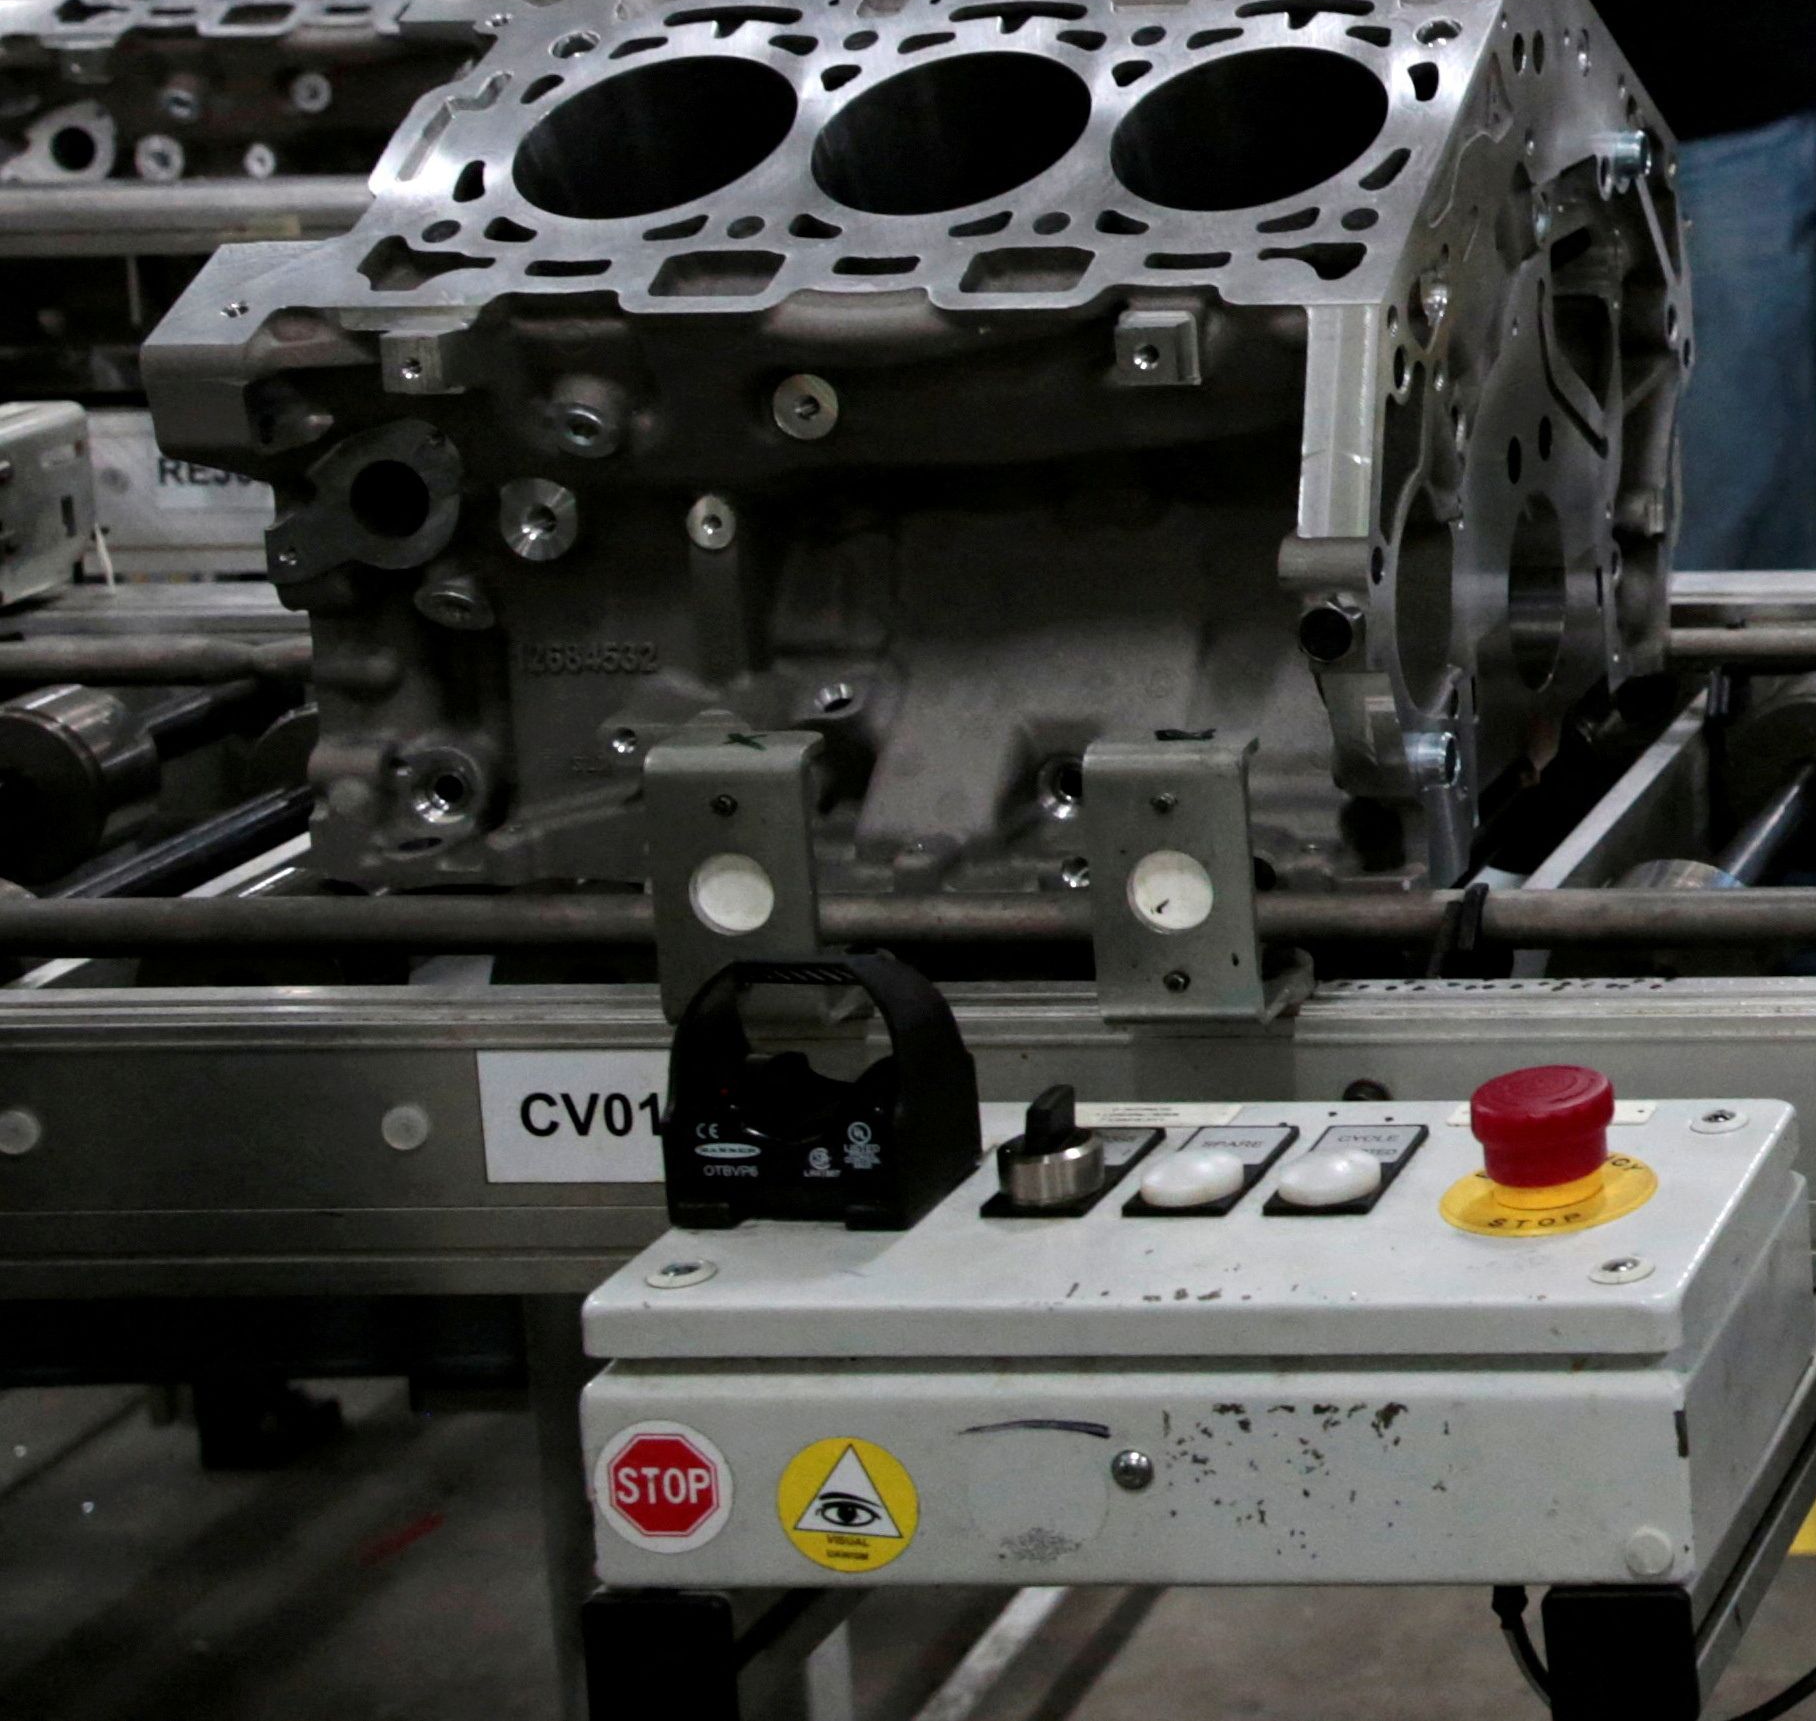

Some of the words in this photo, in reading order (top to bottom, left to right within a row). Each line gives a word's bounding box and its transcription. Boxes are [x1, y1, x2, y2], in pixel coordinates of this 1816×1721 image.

[520, 1092, 664, 1137] CV01
[1201, 1139, 1265, 1149] SPARE
[1336, 1134, 1400, 1143] CYCLE
[1488, 1211, 1582, 1230] STOP
[617, 1466, 712, 1505] STOP
